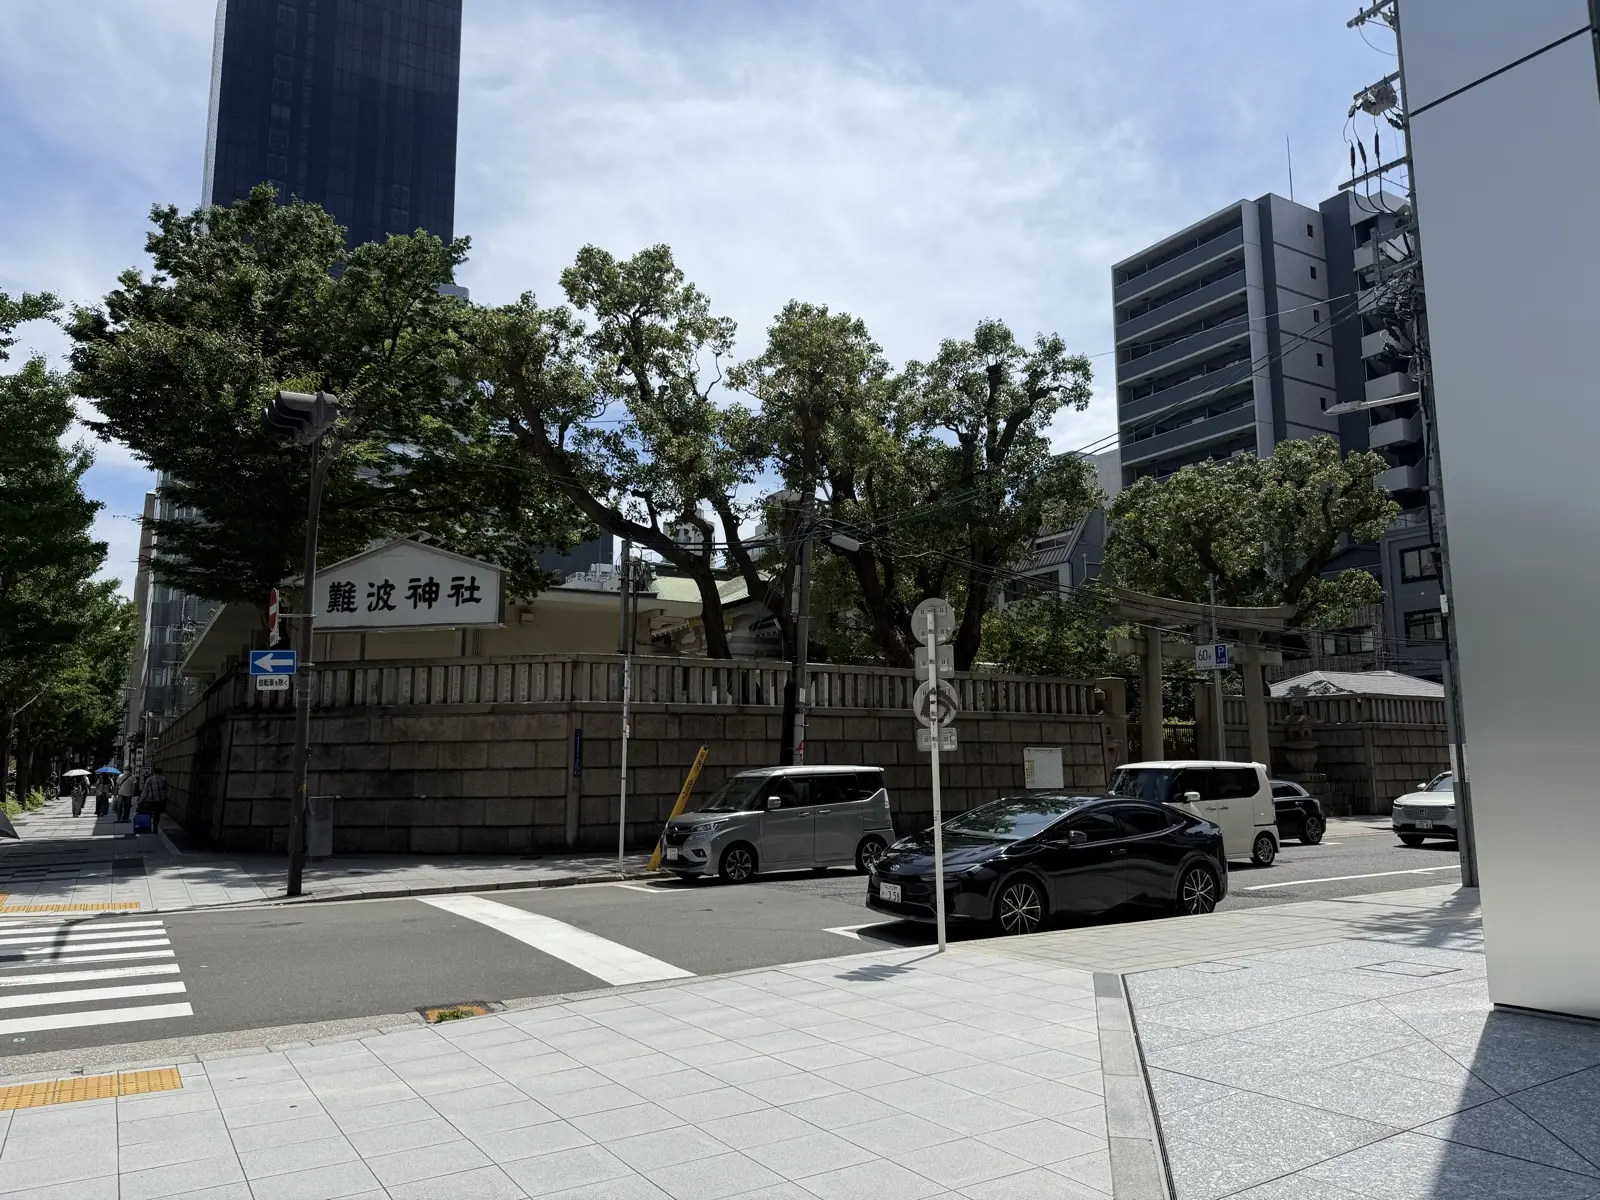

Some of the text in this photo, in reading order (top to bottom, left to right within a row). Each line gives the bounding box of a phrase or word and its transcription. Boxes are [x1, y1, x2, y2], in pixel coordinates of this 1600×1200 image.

[326, 576, 483, 613] 難波神社
[1217, 646, 1224, 657] P
[258, 678, 288, 687] 自転車を除く
